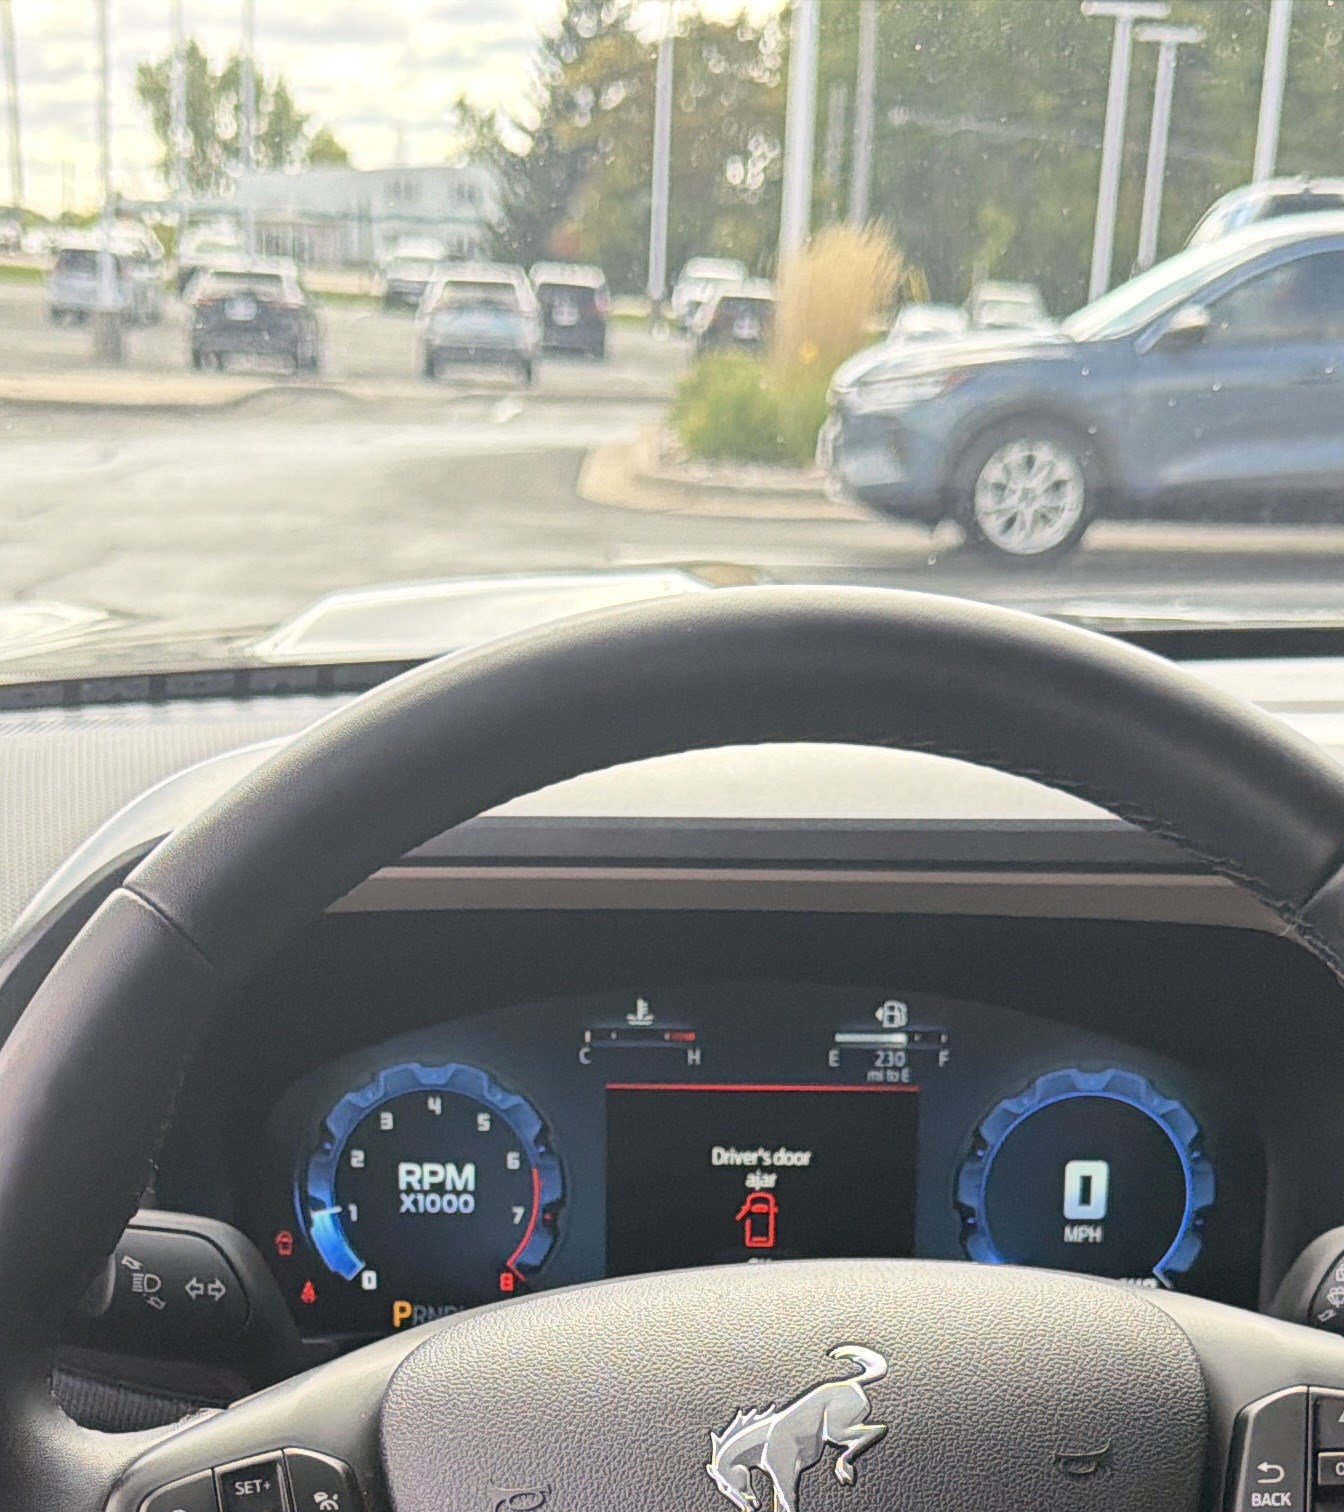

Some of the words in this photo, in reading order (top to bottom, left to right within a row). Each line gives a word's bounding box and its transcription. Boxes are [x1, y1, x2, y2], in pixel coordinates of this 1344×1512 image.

[828, 1048, 841, 1068] E
[874, 1049, 907, 1068] 230
[938, 1048, 950, 1068] F
[427, 1096, 442, 1115] 4
[379, 1111, 394, 1130] 3
[476, 1113, 491, 1132] 5
[350, 1149, 365, 1168] 2
[506, 1151, 521, 1170] 6
[711, 1146, 772, 1166] Driver's
[773, 1146, 812, 1166] door
[397, 1162, 476, 1192] RPM
[1063, 1159, 1110, 1220] 0
[348, 1203, 358, 1222] 1
[399, 1193, 475, 1214] X1000
[512, 1206, 526, 1224] 7
[1064, 1224, 1104, 1243] MPH
[361, 1269, 377, 1290] 0
[234, 1479, 271, 1496] SET+
[1251, 1492, 1292, 1508] BACK
